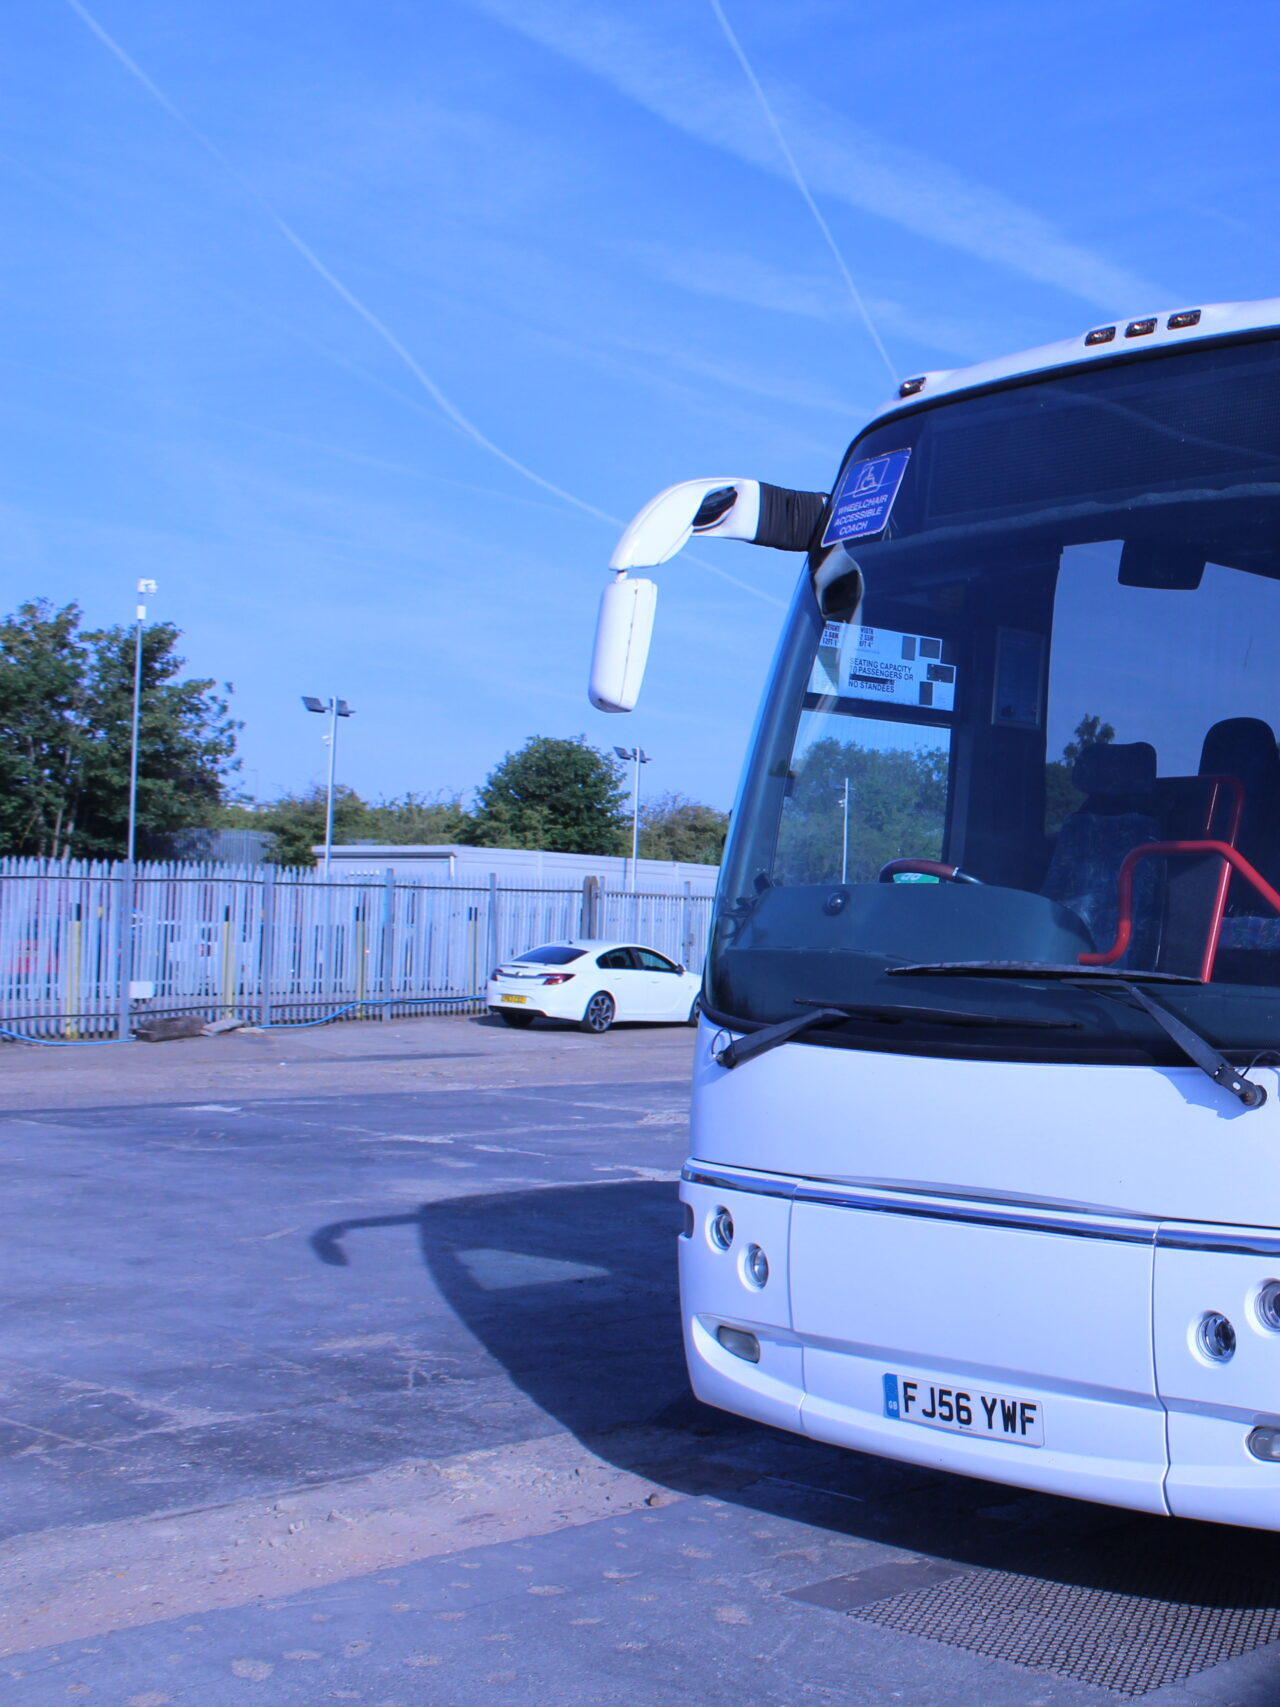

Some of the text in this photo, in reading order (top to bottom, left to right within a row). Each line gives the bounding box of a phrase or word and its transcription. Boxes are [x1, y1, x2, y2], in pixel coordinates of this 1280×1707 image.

[838, 494, 889, 515] WHEELCHAIR
[834, 506, 884, 527] ACCESSIBLE
[839, 521, 868, 535] COACH
[850, 658, 912, 673] SEATING CAPACITY
[858, 666, 903, 680] PASSENGERS
[904, 673, 914, 681] OR
[848, 680, 859, 688] NO
[859, 682, 895, 693] STANDEES
[888, 1400, 898, 1410] GB
[902, 1381, 1037, 1436] FJ56 YWF
